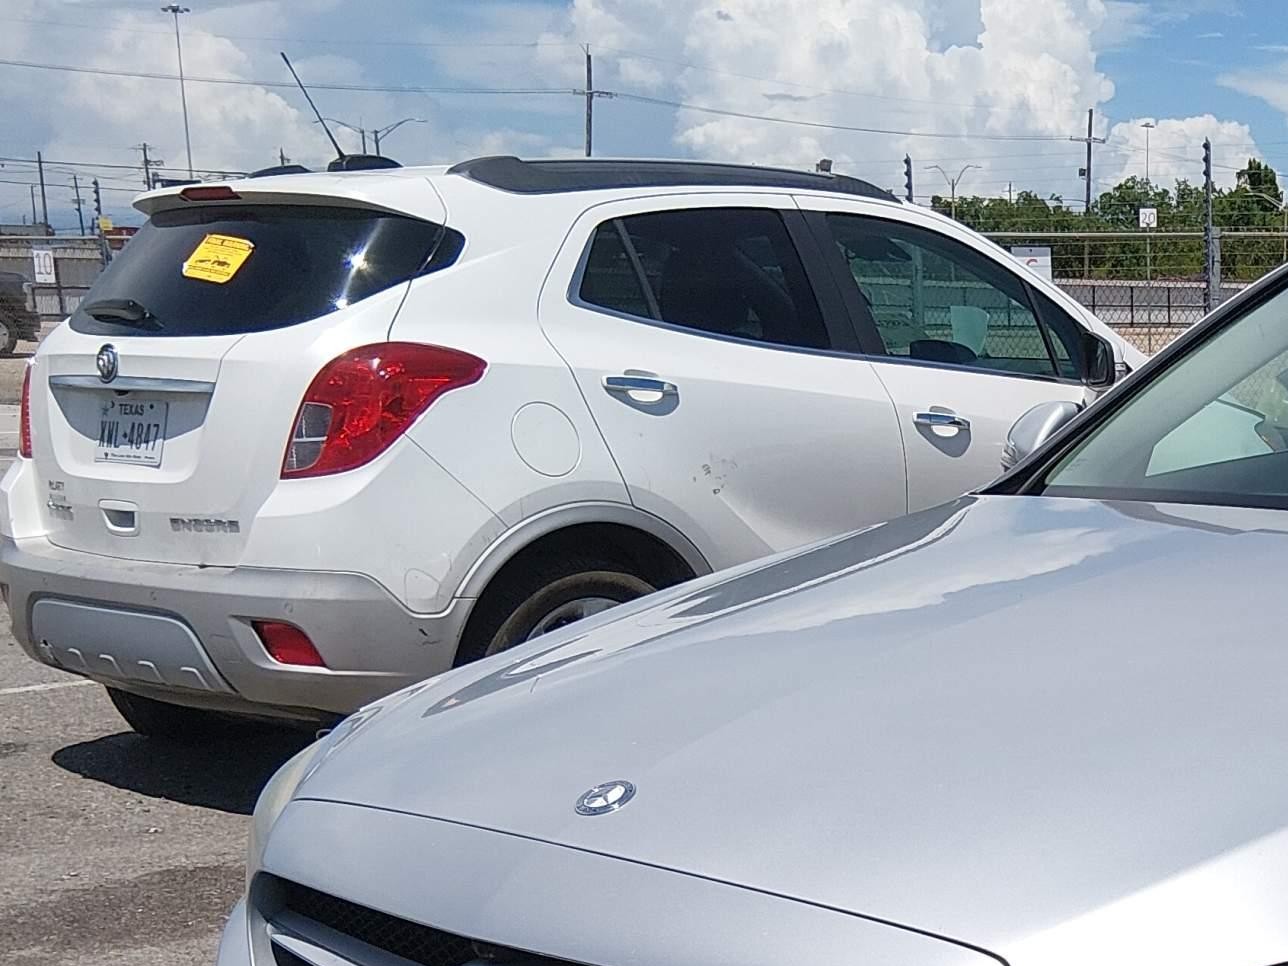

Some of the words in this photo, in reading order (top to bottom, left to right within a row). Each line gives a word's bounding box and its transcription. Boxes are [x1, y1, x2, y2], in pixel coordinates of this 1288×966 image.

[1141, 212, 1156, 225] 20
[35, 252, 53, 275] 10
[119, 403, 145, 416] TEXAS
